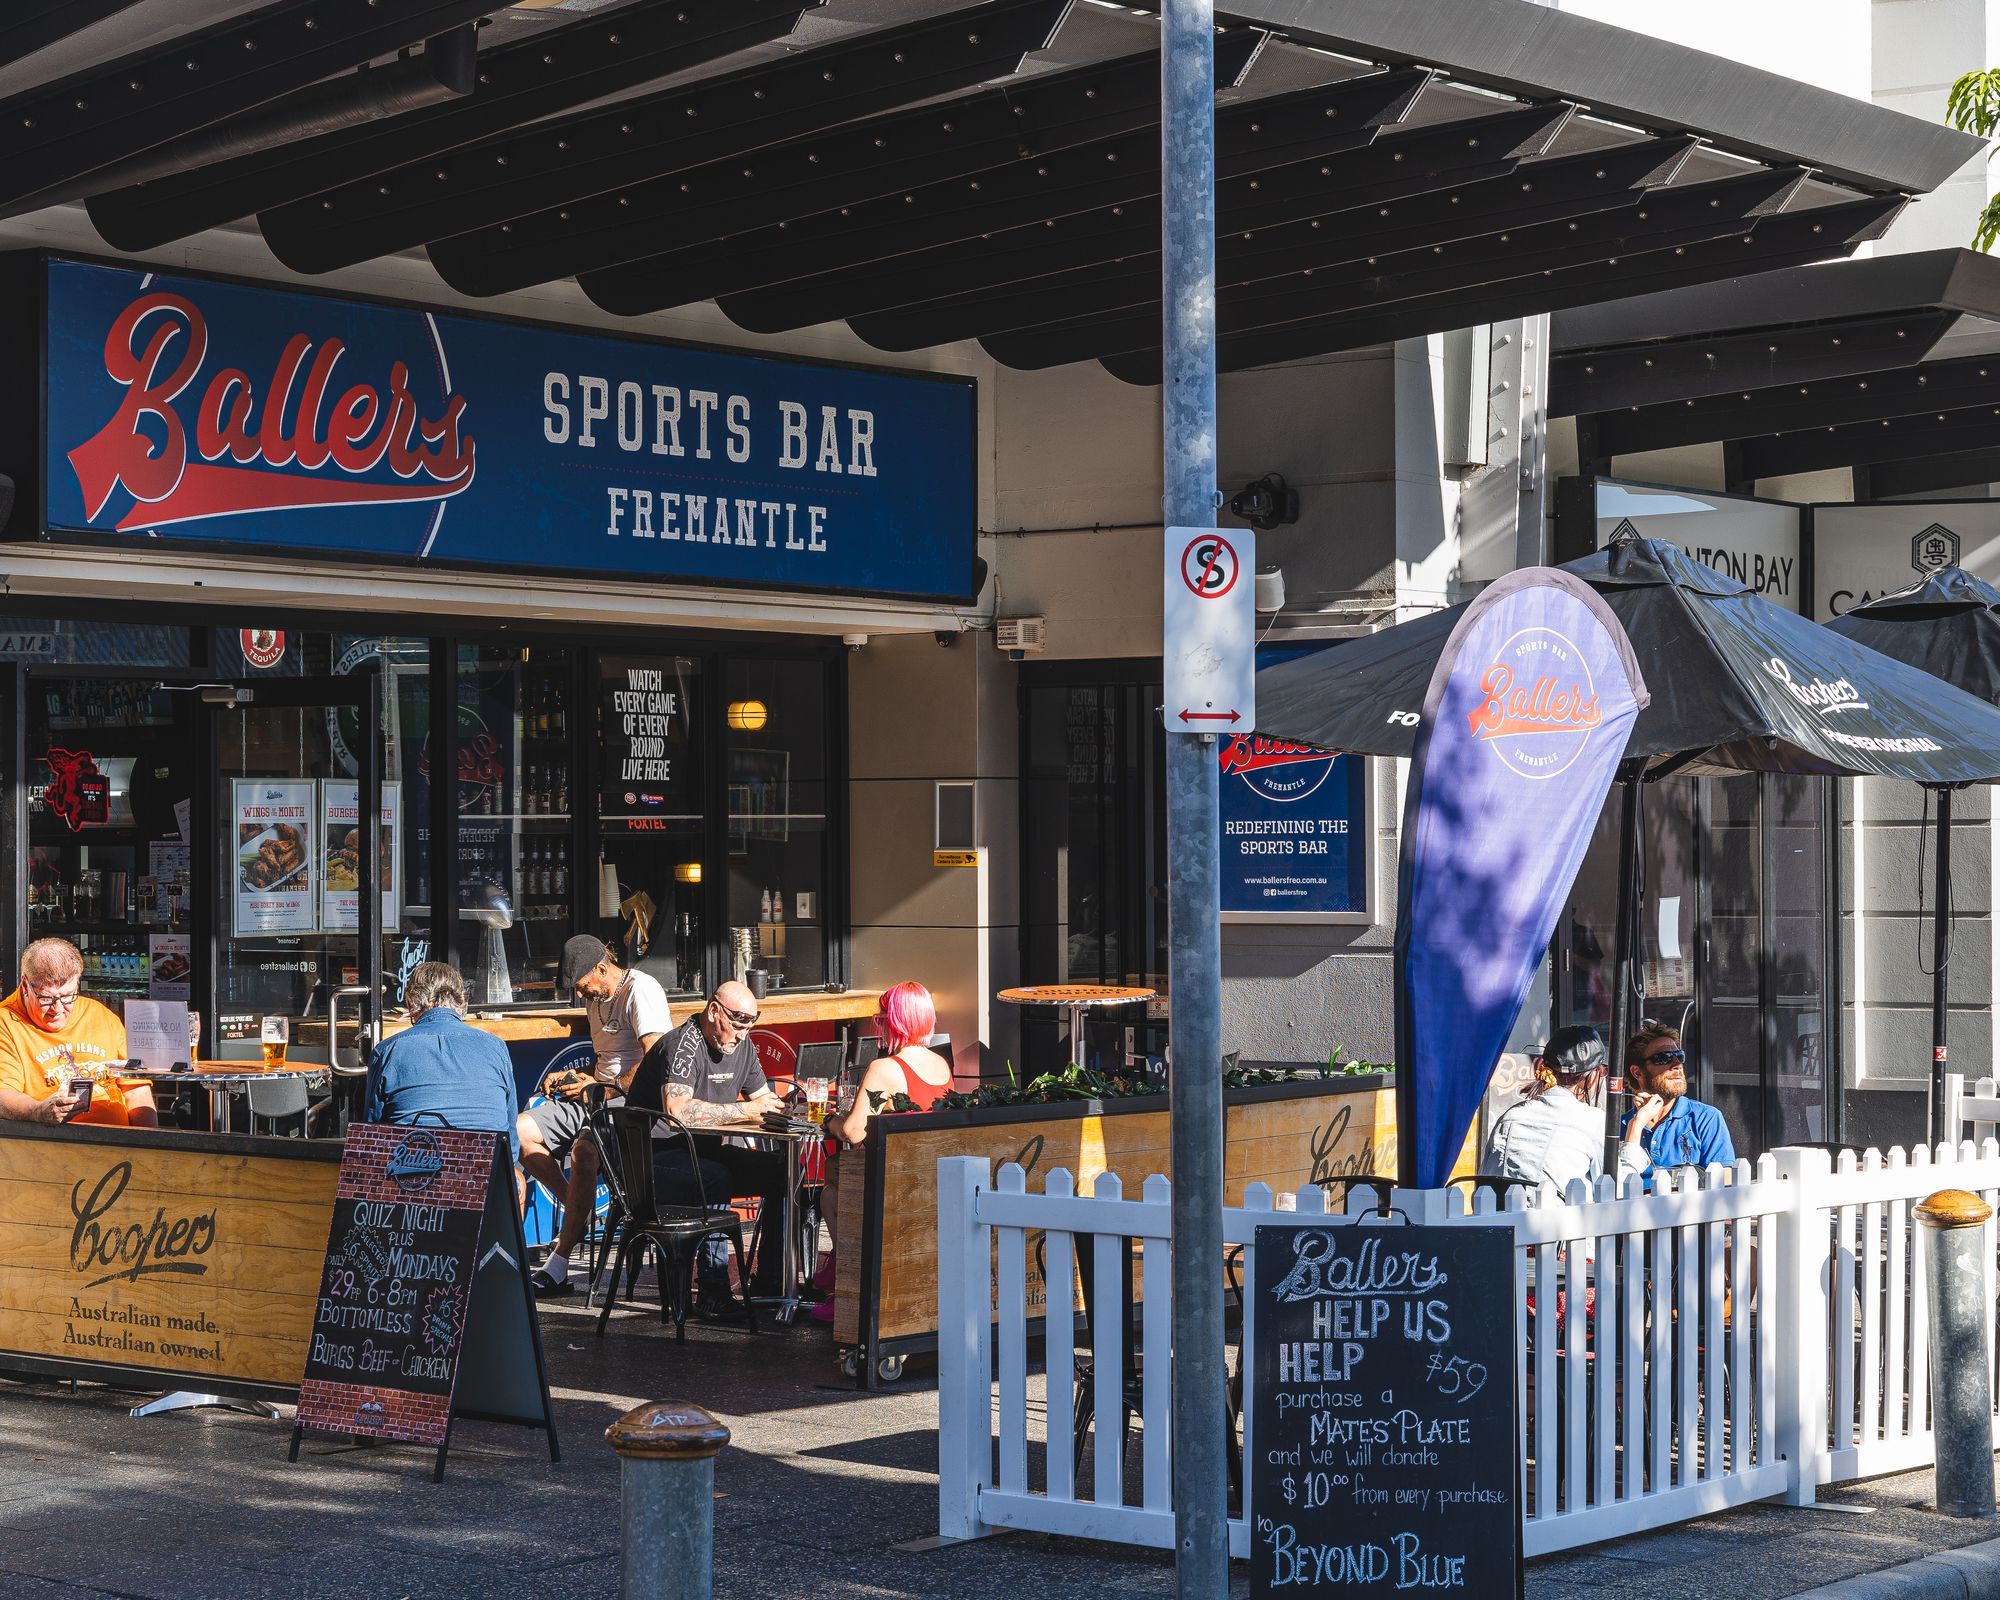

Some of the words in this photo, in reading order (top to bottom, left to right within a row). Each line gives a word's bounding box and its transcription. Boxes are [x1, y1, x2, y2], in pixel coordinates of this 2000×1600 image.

[67, 292, 476, 525] Ballers
[543, 371, 751, 464] SPORTS
[778, 399, 878, 477] BAR
[606, 486, 828, 553] FREMANTLE
[1195, 544, 1225, 589] S
[1754, 553, 1794, 596] BAY
[249, 646, 281, 663] TEQUILA
[1515, 640, 1548, 657] SPORTS
[1551, 645, 1568, 662] BAR
[627, 669, 662, 692] WATCH
[1763, 657, 1860, 714] Coopers
[614, 691, 646, 713] EVERY
[647, 693, 677, 715] GAME
[1467, 663, 1603, 738] Ballers
[623, 714, 636, 736] OF
[638, 715, 670, 736] EVERY
[1386, 710, 1421, 728] FO
[630, 736, 665, 758] ROUND
[1514, 748, 1559, 767] FREMANTLE
[1876, 737, 1943, 753] ORIGINAL
[621, 759, 645, 780] LIVE
[644, 760, 671, 781] HERE
[1263, 778, 1307, 791] FREMANTLE
[243, 806, 270, 818] WINGS
[278, 806, 305, 818] MONTH
[627, 817, 667, 830] FOXTEL
[1225, 820, 1315, 835] REDEFINING
[1318, 819, 1349, 834] THE
[1240, 840, 1294, 855] SPORTS
[1298, 840, 1328, 854] BAR
[1244, 876, 1328, 885] www.ballersfreo.com.au
[1277, 888, 1308, 896] ballersfreo
[76, 1042, 106, 1058] JEANS
[766, 1046, 782, 1062] BAR
[562, 1056, 591, 1073] PORTS
[70, 1161, 217, 1284] Coopers
[354, 1201, 396, 1229] QUIZ
[401, 1203, 450, 1232] NIGHT
[360, 1230, 386, 1265] SELECTED
[387, 1231, 415, 1246] PLUS
[327, 1254, 347, 1266] ONLY
[385, 1247, 460, 1283] MONDAYS
[1267, 1229, 1448, 1302] Ballers
[67, 1297, 161, 1328] Australian
[166, 1312, 220, 1334] made.
[318, 1298, 413, 1333] BOTTOMLESS
[431, 1313, 451, 1332] DRINK
[1312, 1300, 1391, 1341] HELP
[1403, 1300, 1453, 1344] US
[62, 1323, 156, 1354] Australian
[159, 1341, 225, 1362] owned.
[312, 1333, 355, 1370] BURGS
[358, 1338, 393, 1373] BEEF
[400, 1344, 452, 1380] CHICKEN
[1279, 1342, 1365, 1383] HELP
[1425, 1350, 1488, 1404] $59
[1275, 1384, 1364, 1419] purchase
[1380, 1388, 1393, 1405] a
[1391, 1409, 1472, 1445] PLATE
[1268, 1442, 1300, 1467] and
[1310, 1448, 1335, 1466] we
[1345, 1442, 1372, 1466] will
[1381, 1442, 1440, 1466] donate
[1351, 1472, 1389, 1505] from
[1394, 1488, 1430, 1511] every
[1269, 1523, 1389, 1589] BEYOND
[1391, 1531, 1466, 1590] BLUE
